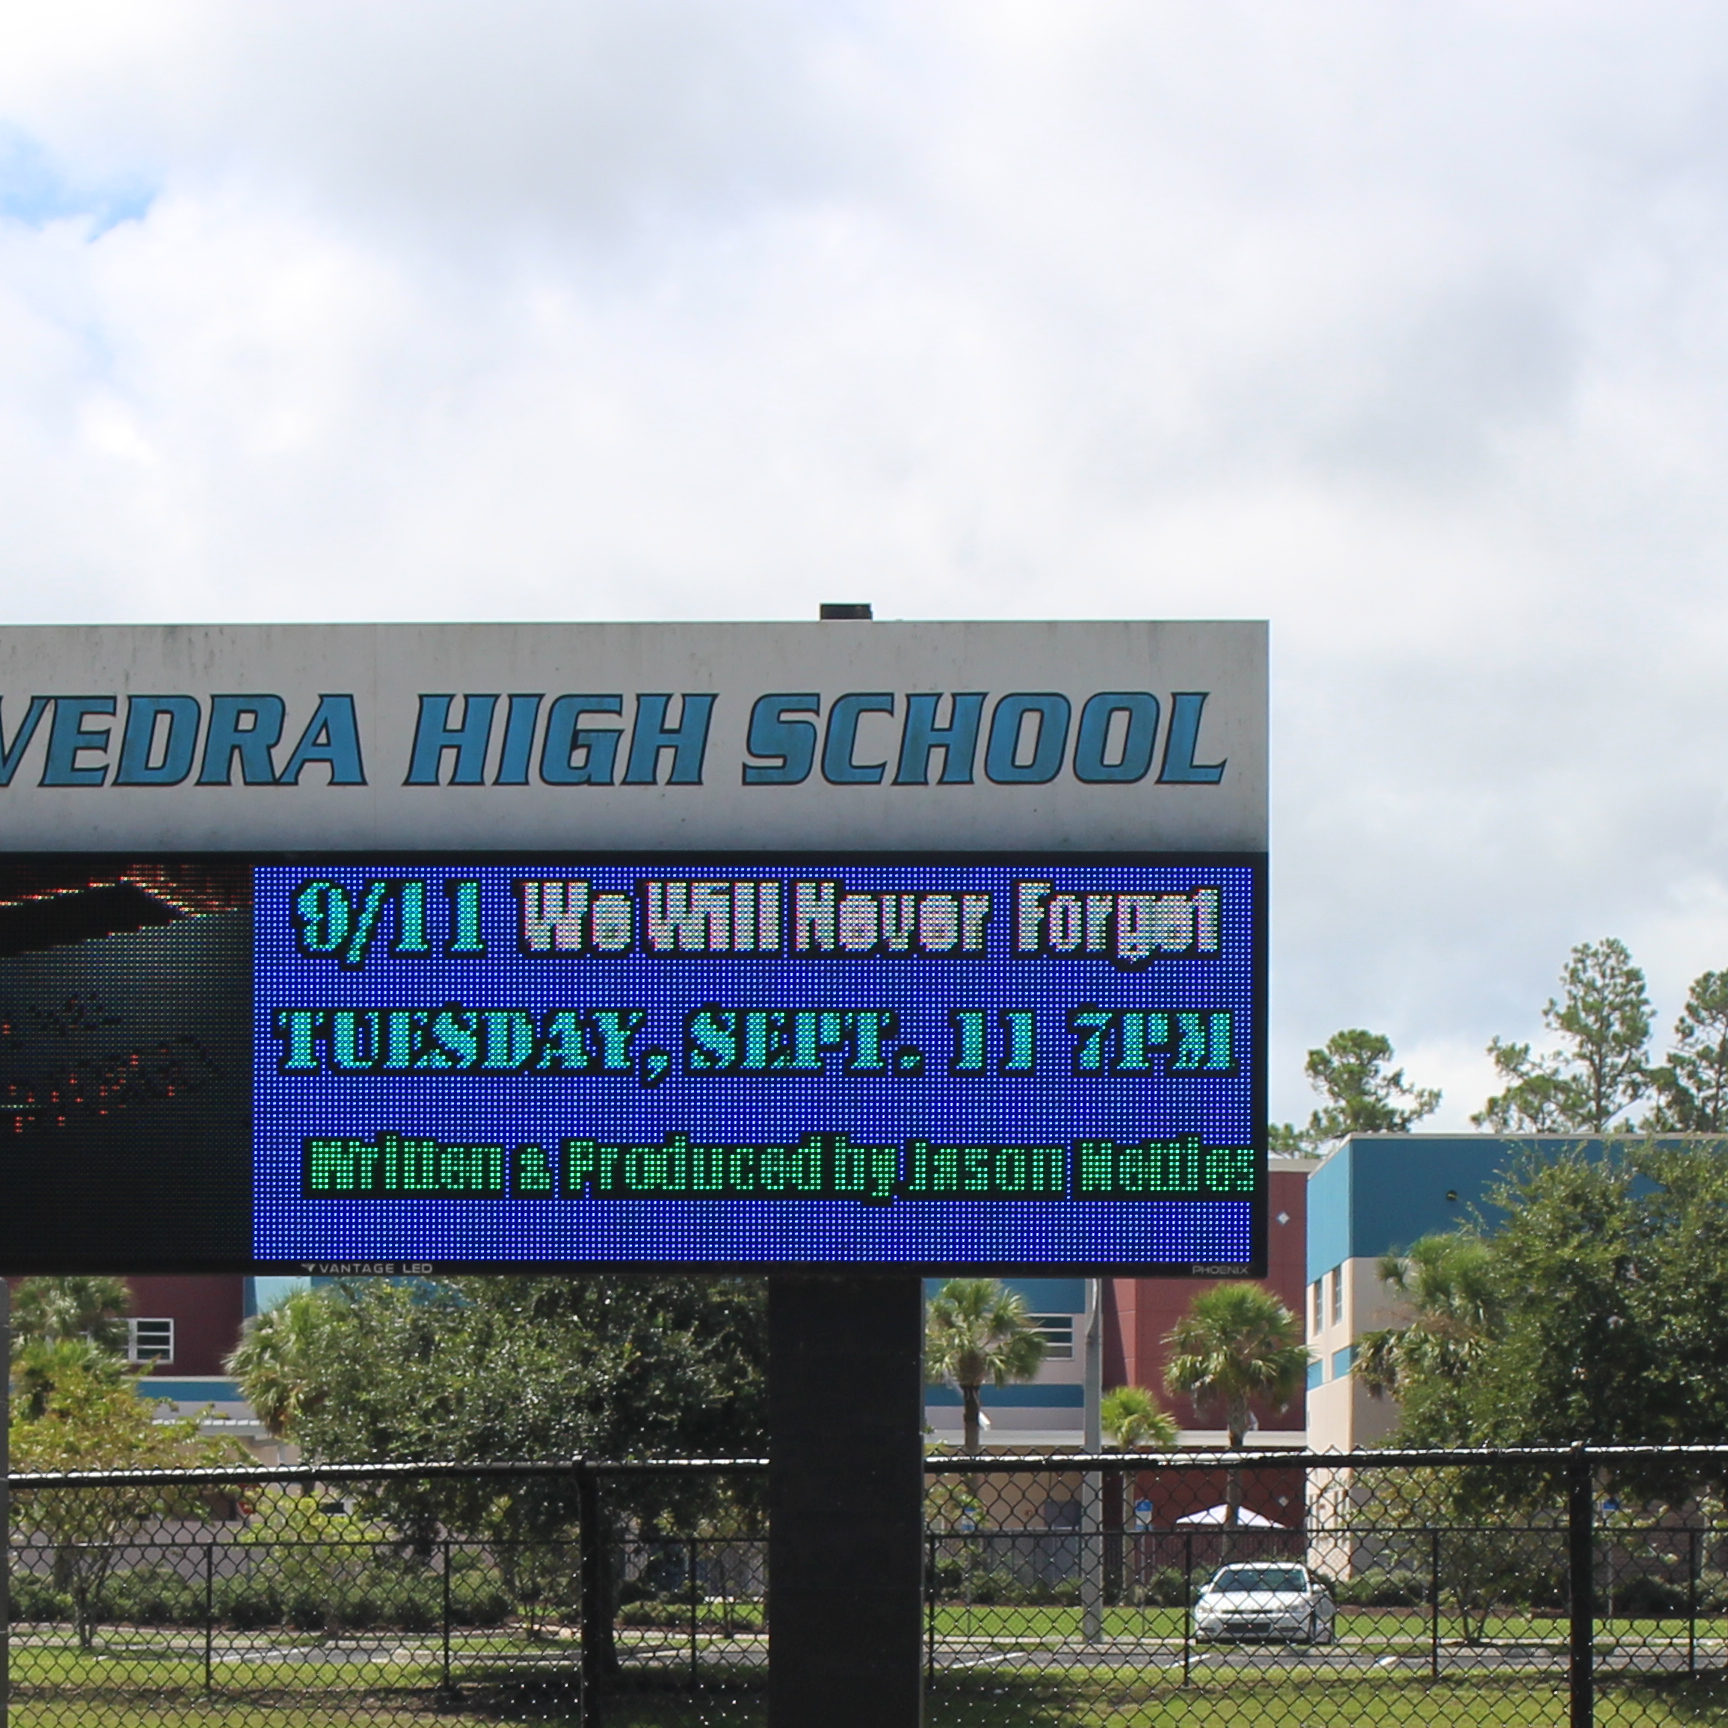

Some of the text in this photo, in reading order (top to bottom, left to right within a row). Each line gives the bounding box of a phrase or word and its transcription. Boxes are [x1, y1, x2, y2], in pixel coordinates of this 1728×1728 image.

[403, 692, 720, 787] HIGH
[741, 690, 1228, 786] SCHOOL
[296, 881, 1219, 964] 9/11 We Will Never Forget
[278, 1011, 1236, 1081] TUESDAY, SEPT. 11 7PM
[311, 1135, 502, 1190] Written
[568, 1135, 822, 1191] Produced
[834, 1135, 897, 1197] by
[908, 1141, 1063, 1192] Jason
[319, 1263, 433, 1274] VANTAGE LED
[1192, 1265, 1249, 1275] PHOENIX
